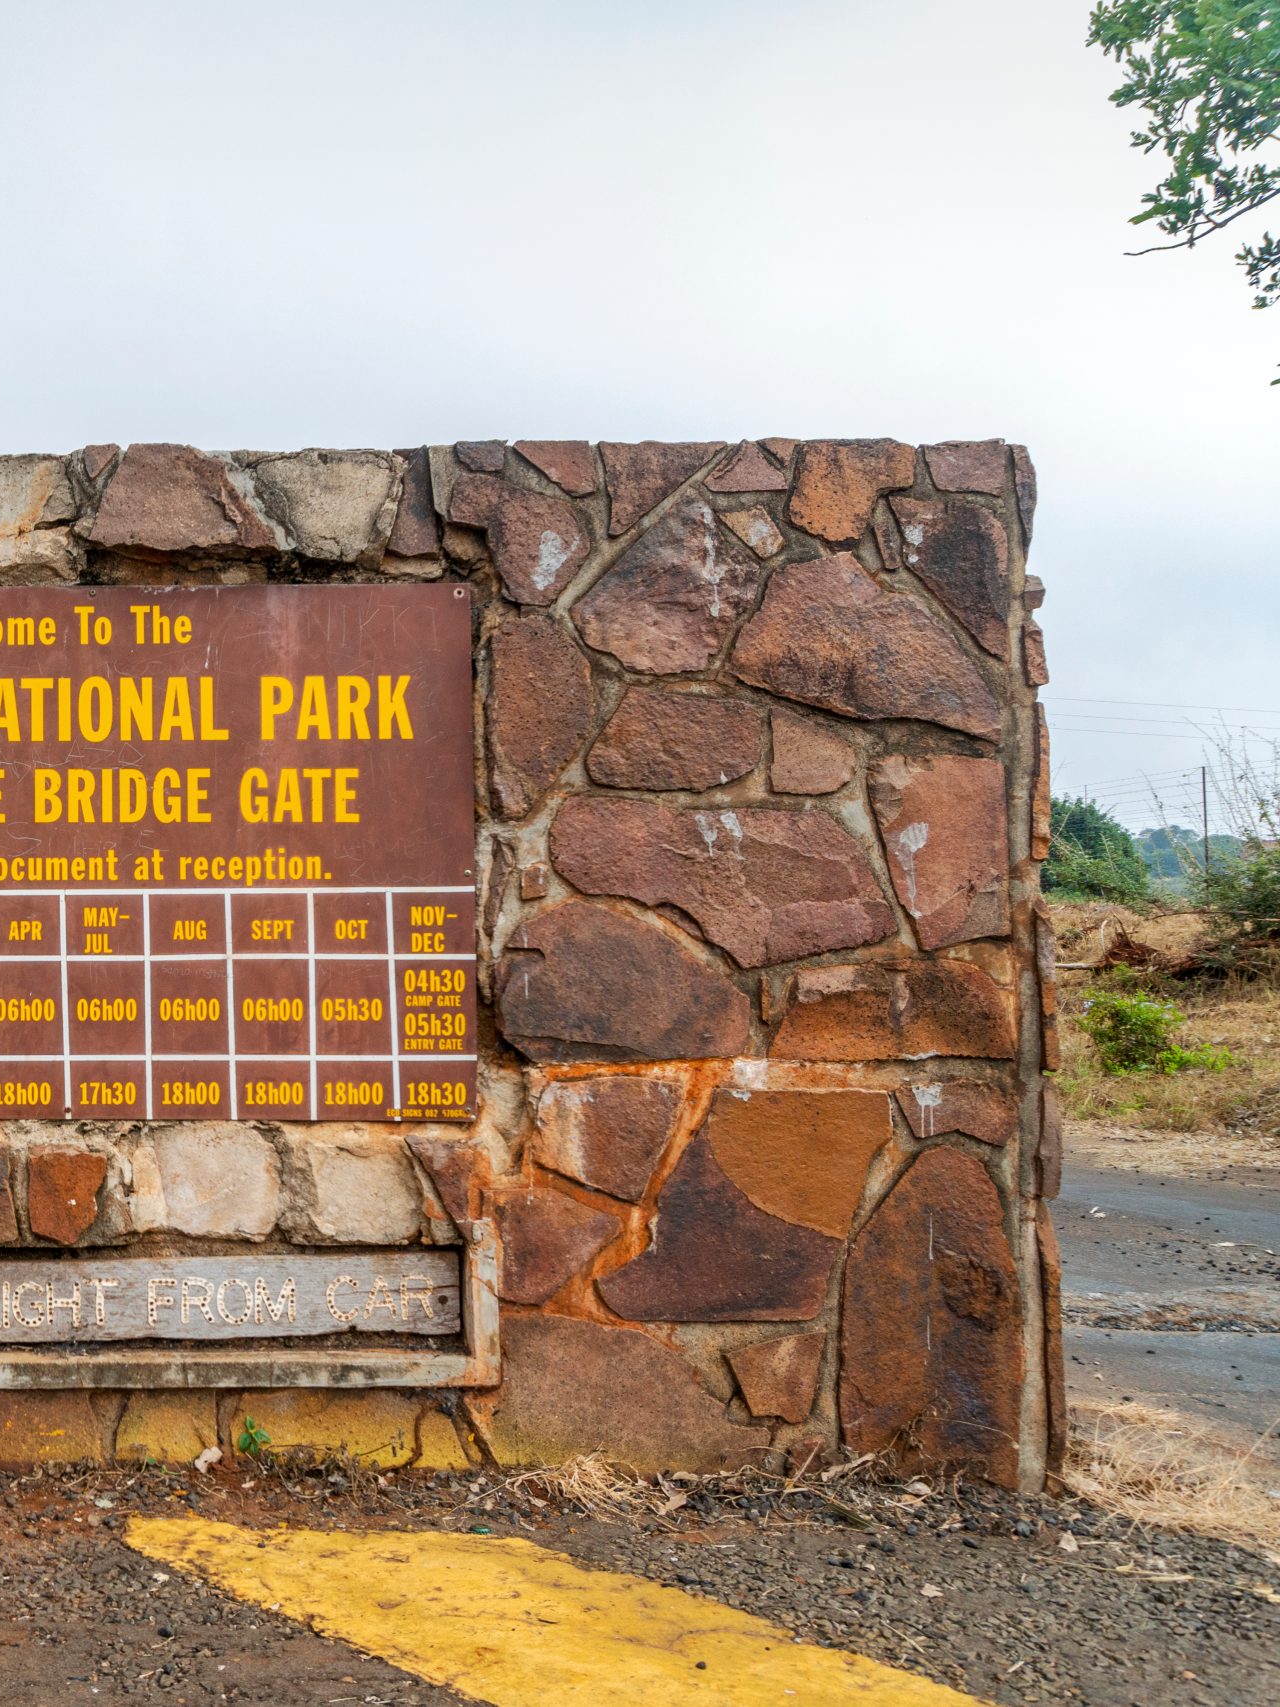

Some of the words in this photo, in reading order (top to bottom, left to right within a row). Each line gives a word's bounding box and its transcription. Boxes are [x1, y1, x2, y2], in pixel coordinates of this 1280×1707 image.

[74, 605, 112, 646] To
[130, 604, 193, 645] The
[260, 674, 415, 741] PARK
[34, 767, 213, 825] BRIDGE
[239, 766, 362, 824] GATE
[133, 848, 165, 882] at
[178, 847, 334, 888] reception.
[83, 907, 130, 928] MAY-
[410, 906, 458, 927] NOV-
[8, 920, 42, 941] APR
[173, 919, 208, 941] AUG
[251, 919, 295, 941] SEPT
[335, 919, 369, 940] OCT
[84, 933, 113, 955] JUL
[411, 932, 446, 953] DEC
[404, 969, 466, 993] 04h30
[76, 998, 138, 1022] 06h00
[160, 998, 221, 1022] 06h00
[242, 998, 304, 1022] 06h00
[321, 998, 383, 1022] 05h30
[405, 995, 433, 1008] CAMP
[437, 995, 461, 1007] GATE
[404, 1013, 466, 1037] 05h30
[404, 1038, 435, 1051] ENTRY
[439, 1038, 463, 1051] GATE
[79, 1081, 137, 1106] 17h30
[162, 1081, 220, 1106] 18h00
[245, 1081, 304, 1106] 18h00
[325, 1081, 384, 1106] 18h00
[407, 1081, 466, 1106] 18h30
[402, 1108, 423, 1117] SIGNS
[147, 1276, 297, 1326] FROM
[326, 1273, 434, 1322] CAR
